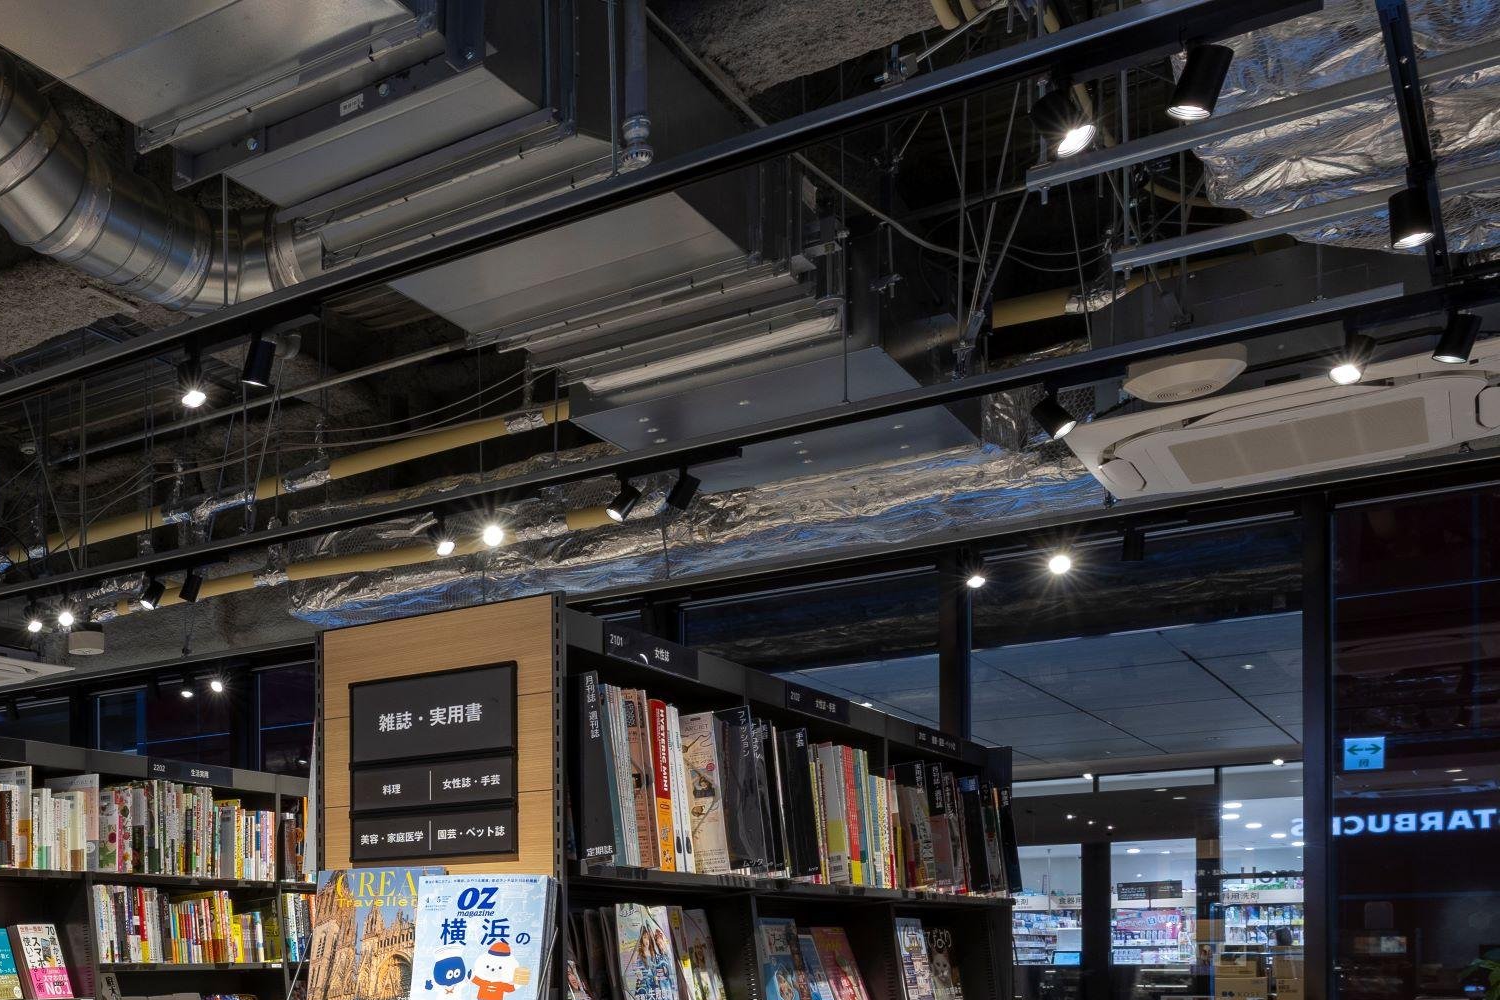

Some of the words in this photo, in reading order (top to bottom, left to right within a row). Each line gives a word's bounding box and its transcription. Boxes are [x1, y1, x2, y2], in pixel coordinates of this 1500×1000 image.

[378, 702, 483, 733] 雑誌・実用書
[658, 708, 668, 763] HYSTERIC
[153, 763, 166, 772] 2202
[382, 783, 402, 796] 料理
[442, 774, 501, 791] 女性誌・手芸
[360, 830, 424, 846] 美容・家庭医学
[437, 825, 506, 841] 園芸・ペット誌
[336, 870, 418, 898] CREA
[457, 886, 499, 911] OZ
[456, 910, 495, 918] magazine
